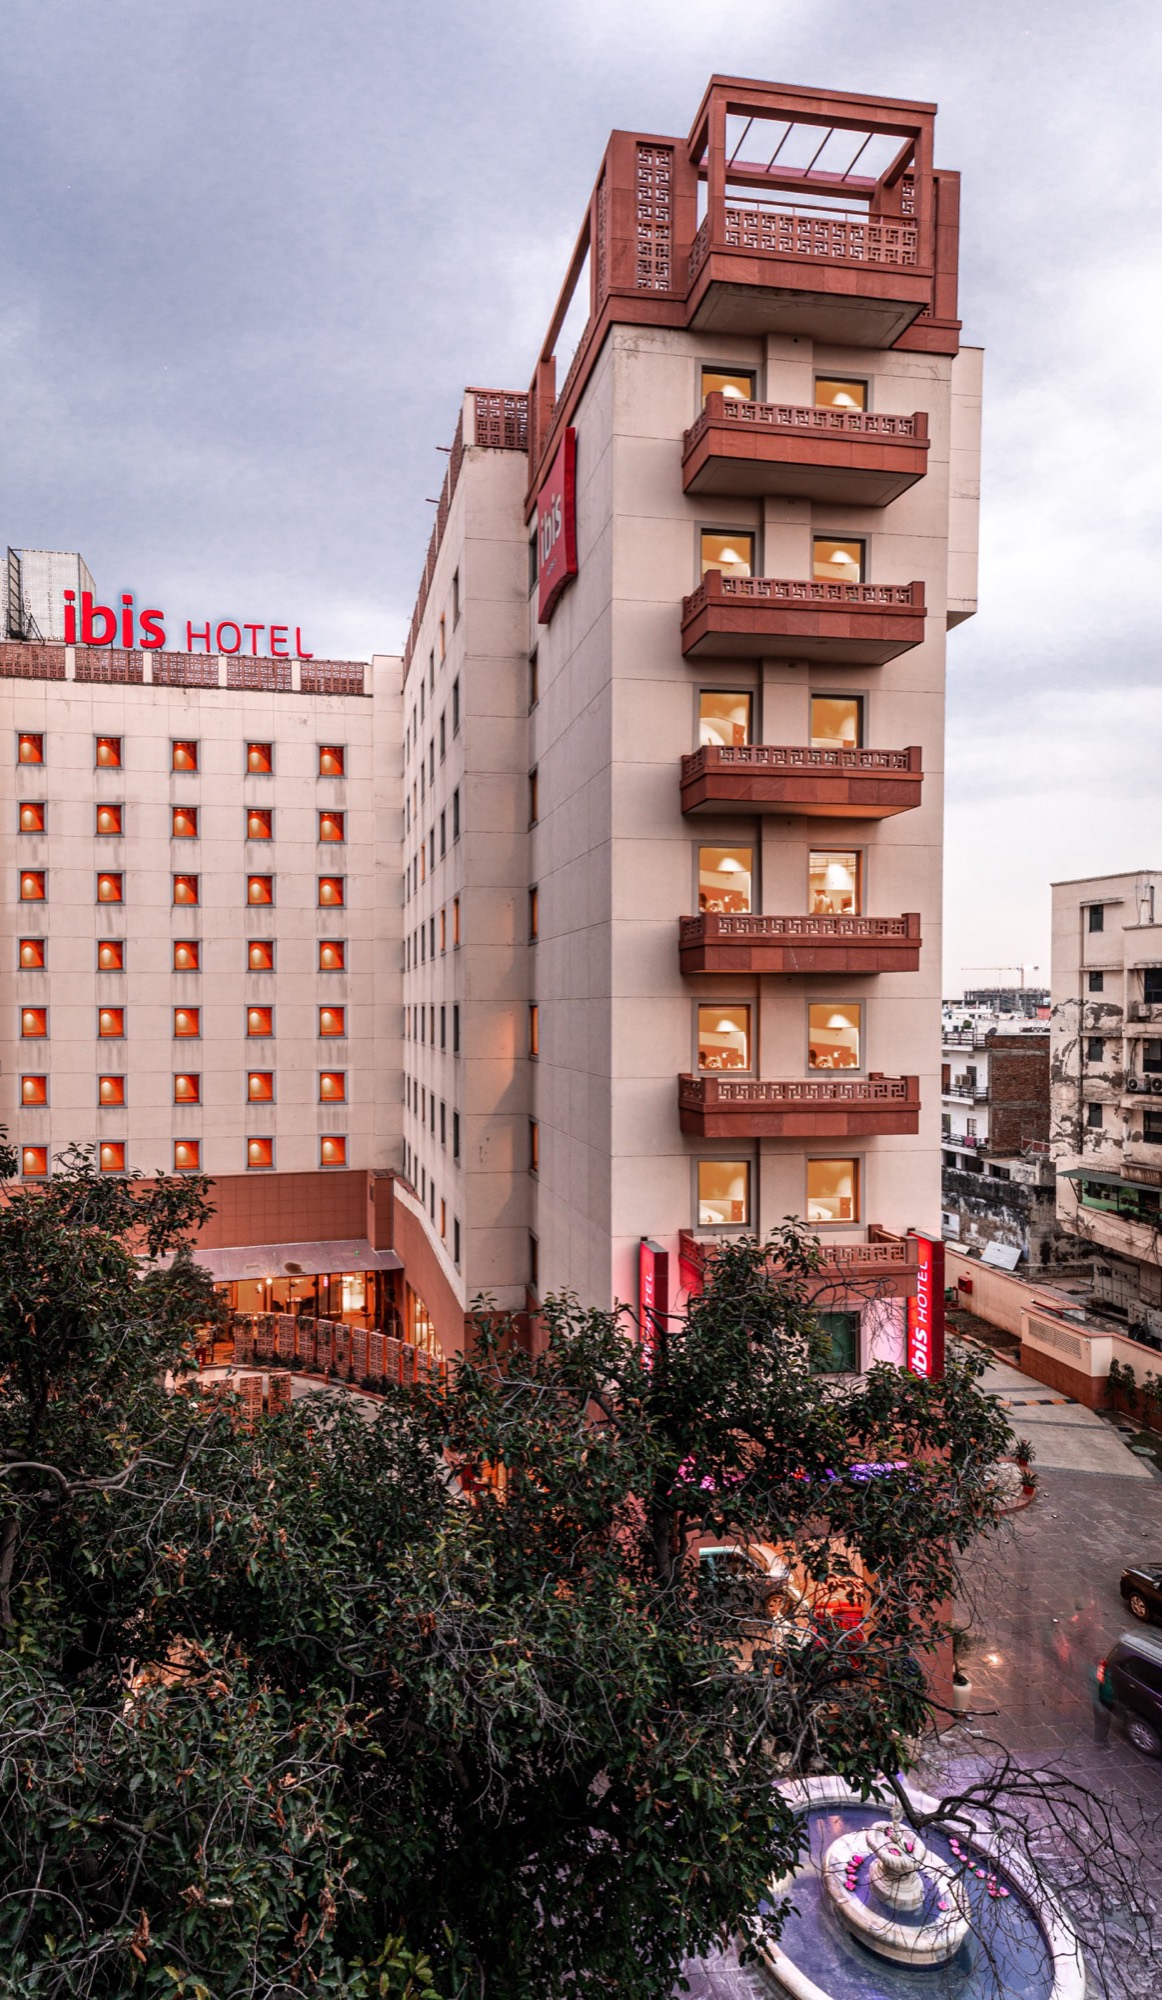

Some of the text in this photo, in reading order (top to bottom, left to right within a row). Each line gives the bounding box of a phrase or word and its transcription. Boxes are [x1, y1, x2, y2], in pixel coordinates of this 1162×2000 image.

[541, 493, 561, 568] ibis
[63, 589, 313, 658] ibis HOTEL
[917, 1261, 928, 1323] HOTEL
